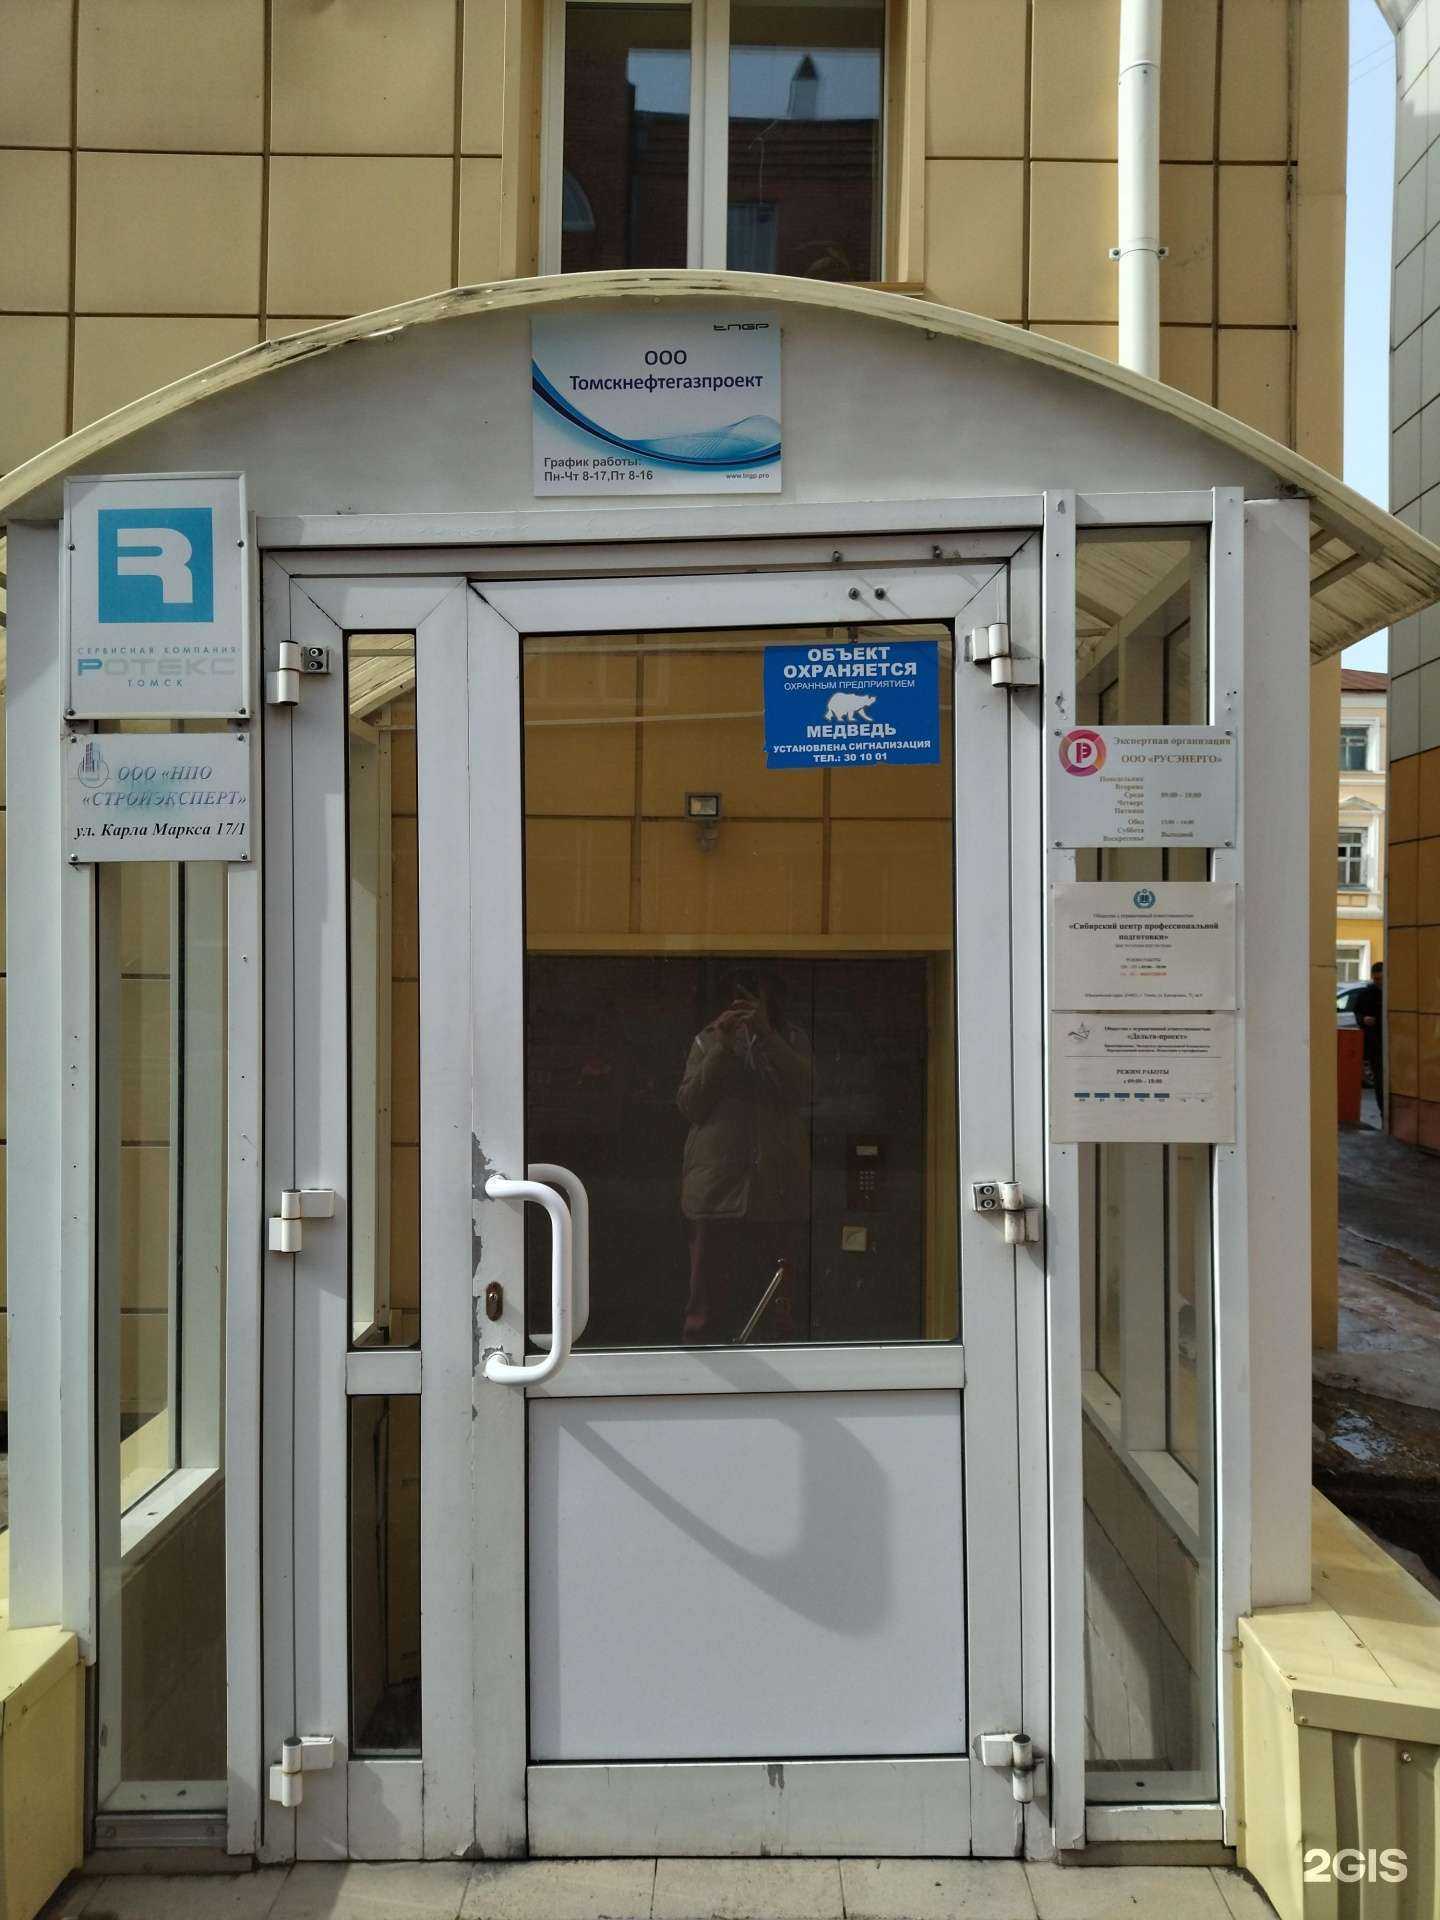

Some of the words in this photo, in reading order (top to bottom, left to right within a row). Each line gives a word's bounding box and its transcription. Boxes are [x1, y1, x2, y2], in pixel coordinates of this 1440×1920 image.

[644, 350, 688, 366] ООО
[569, 374, 764, 393] Томскнефтегазпроект
[544, 456, 590, 470] График
[592, 455, 642, 469] работы:
[544, 470, 580, 482] Пн-Чт
[582, 470, 626, 483] 8-17,Пт
[628, 470, 653, 482] 8-16
[78, 646, 155, 655] СЕРВИСНАЯ
[164, 646, 237, 654] КОМПАНИЯ
[807, 646, 890, 662] ОБЪЕКТ
[77, 658, 236, 677] РОТЕКС
[783, 662, 917, 679] ОХРАНЯЕТСЯ
[128, 679, 183, 687] ТОМСК
[784, 682, 837, 691] ОХРАННЫМ
[839, 680, 915, 689] ПРЕДПРИЯТИЕМ
[806, 723, 896, 739] МЕДВЕДЬ
[773, 744, 847, 753] УСТАНОВЛЕНА
[848, 740, 931, 751] СИГНАЛИЗАЦИЯ
[1113, 737, 1169, 746] Экспертная
[1171, 736, 1231, 746] организация
[813, 754, 841, 763] ТЕЛ.:
[843, 753, 857, 762] 30
[860, 753, 872, 761] 10
[875, 752, 888, 761] 01
[1121, 754, 1146, 763] ООО
[1148, 753, 1222, 763] «РУСЭНЕРГО»
[117, 766, 157, 780] ООО
[161, 766, 213, 780] «НПО
[82, 791, 247, 807] «СТРОЙЭКСПЕРТ»
[74, 825, 96, 840] ул.
[101, 823, 148, 839] Карла
[153, 822, 211, 839] Маркса
[216, 822, 246, 836] 17/1
[1069, 922, 1117, 931] «Сибирский
[1144, 922, 1219, 931] профессиональной
